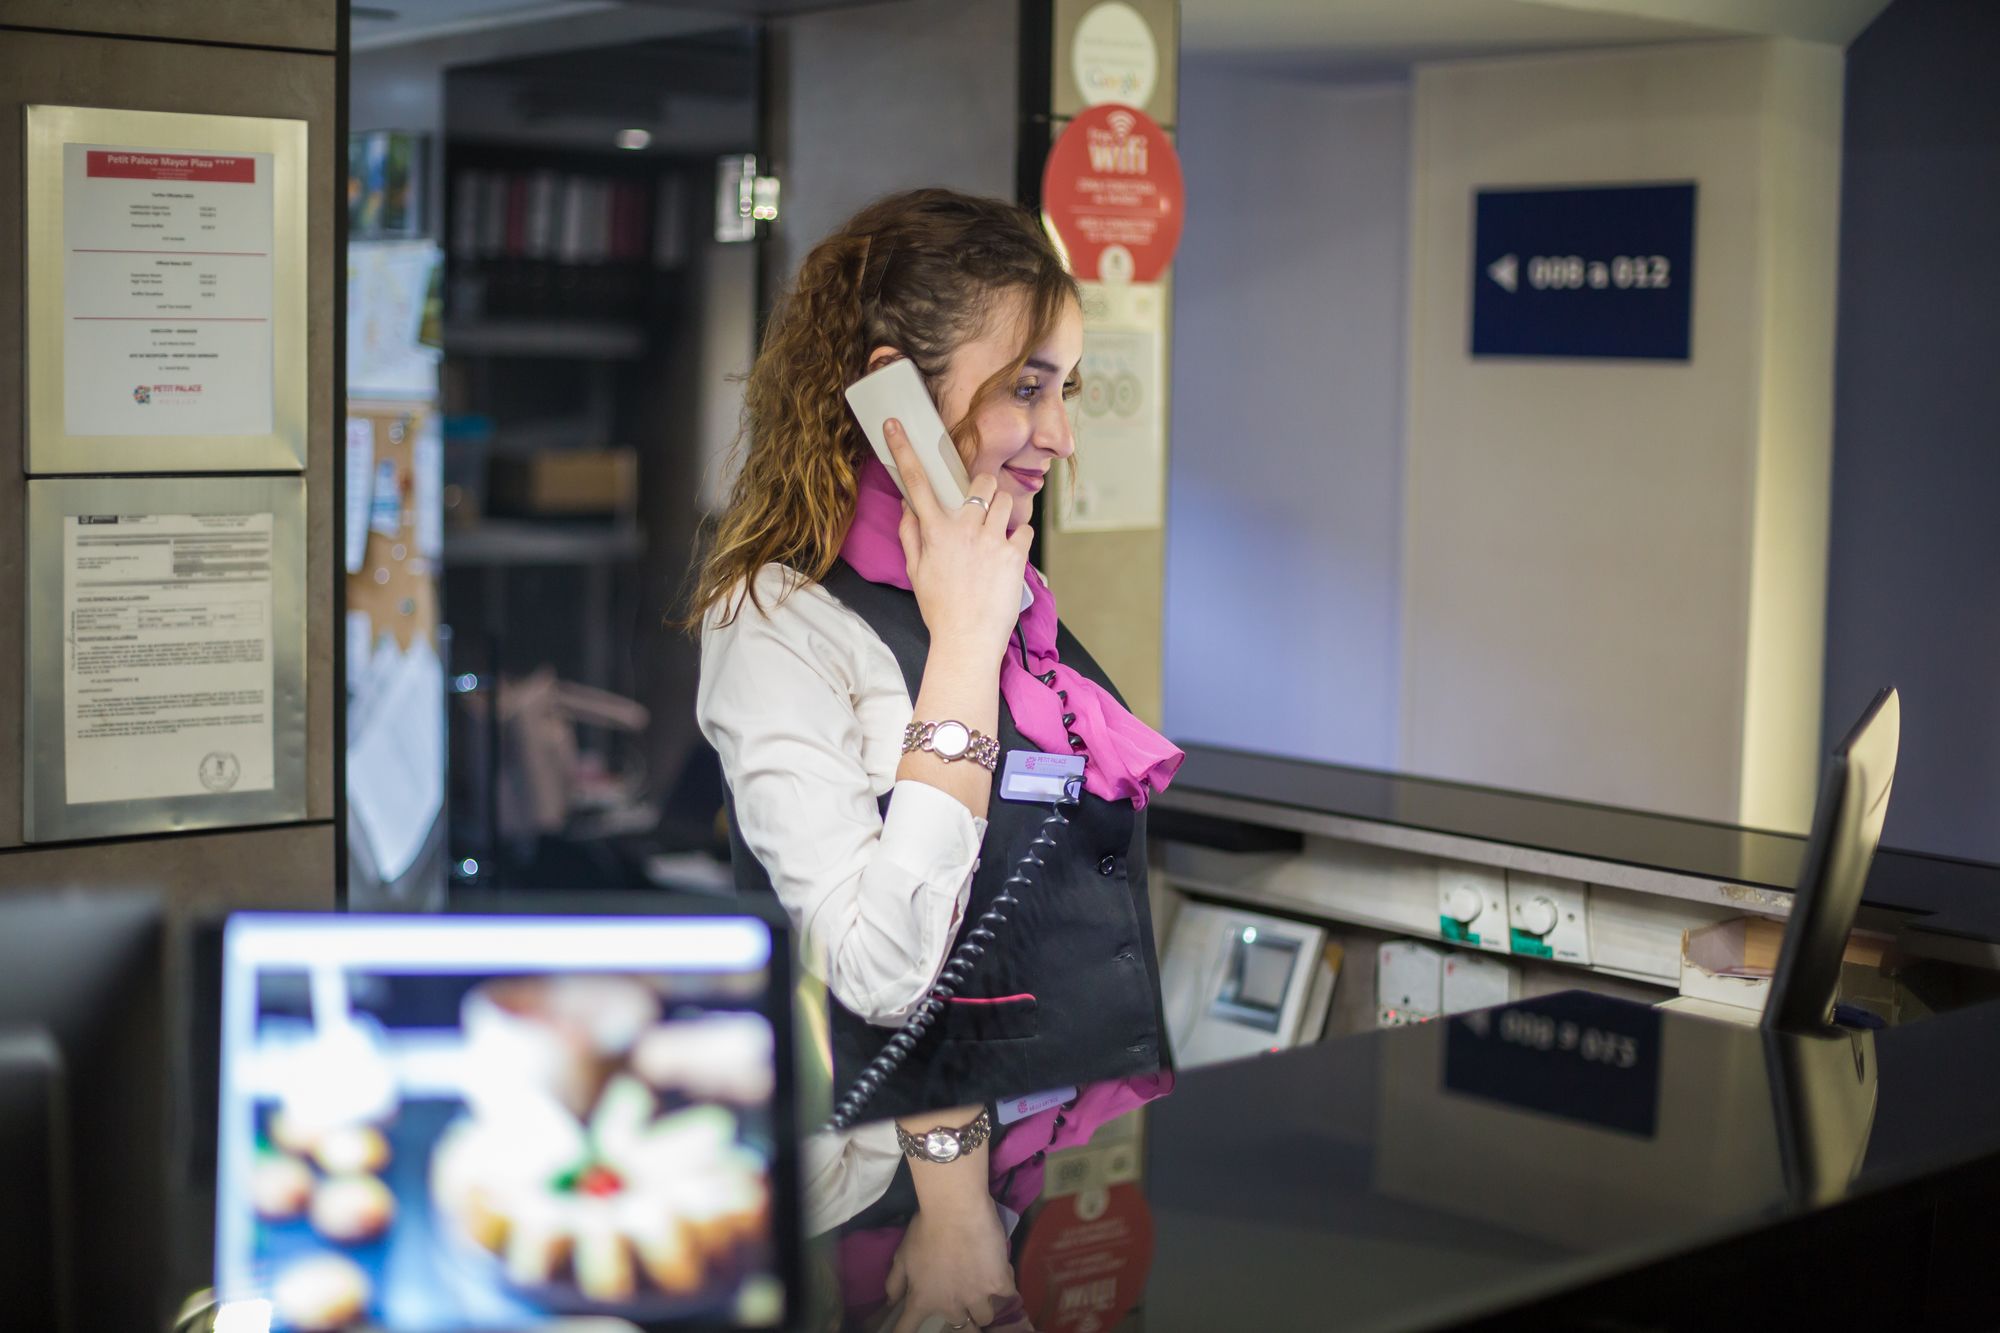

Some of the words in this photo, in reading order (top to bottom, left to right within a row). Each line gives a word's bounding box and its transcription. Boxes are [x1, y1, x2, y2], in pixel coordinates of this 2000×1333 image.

[107, 154, 129, 165] Petit
[130, 156, 159, 166] Palace
[160, 158, 190, 169] Mayor
[190, 158, 214, 168] Plaza
[1587, 260, 1610, 290] a
[1611, 254, 1671, 289] 012
[153, 384, 174, 393] PETIT
[175, 384, 203, 393] PALACE
